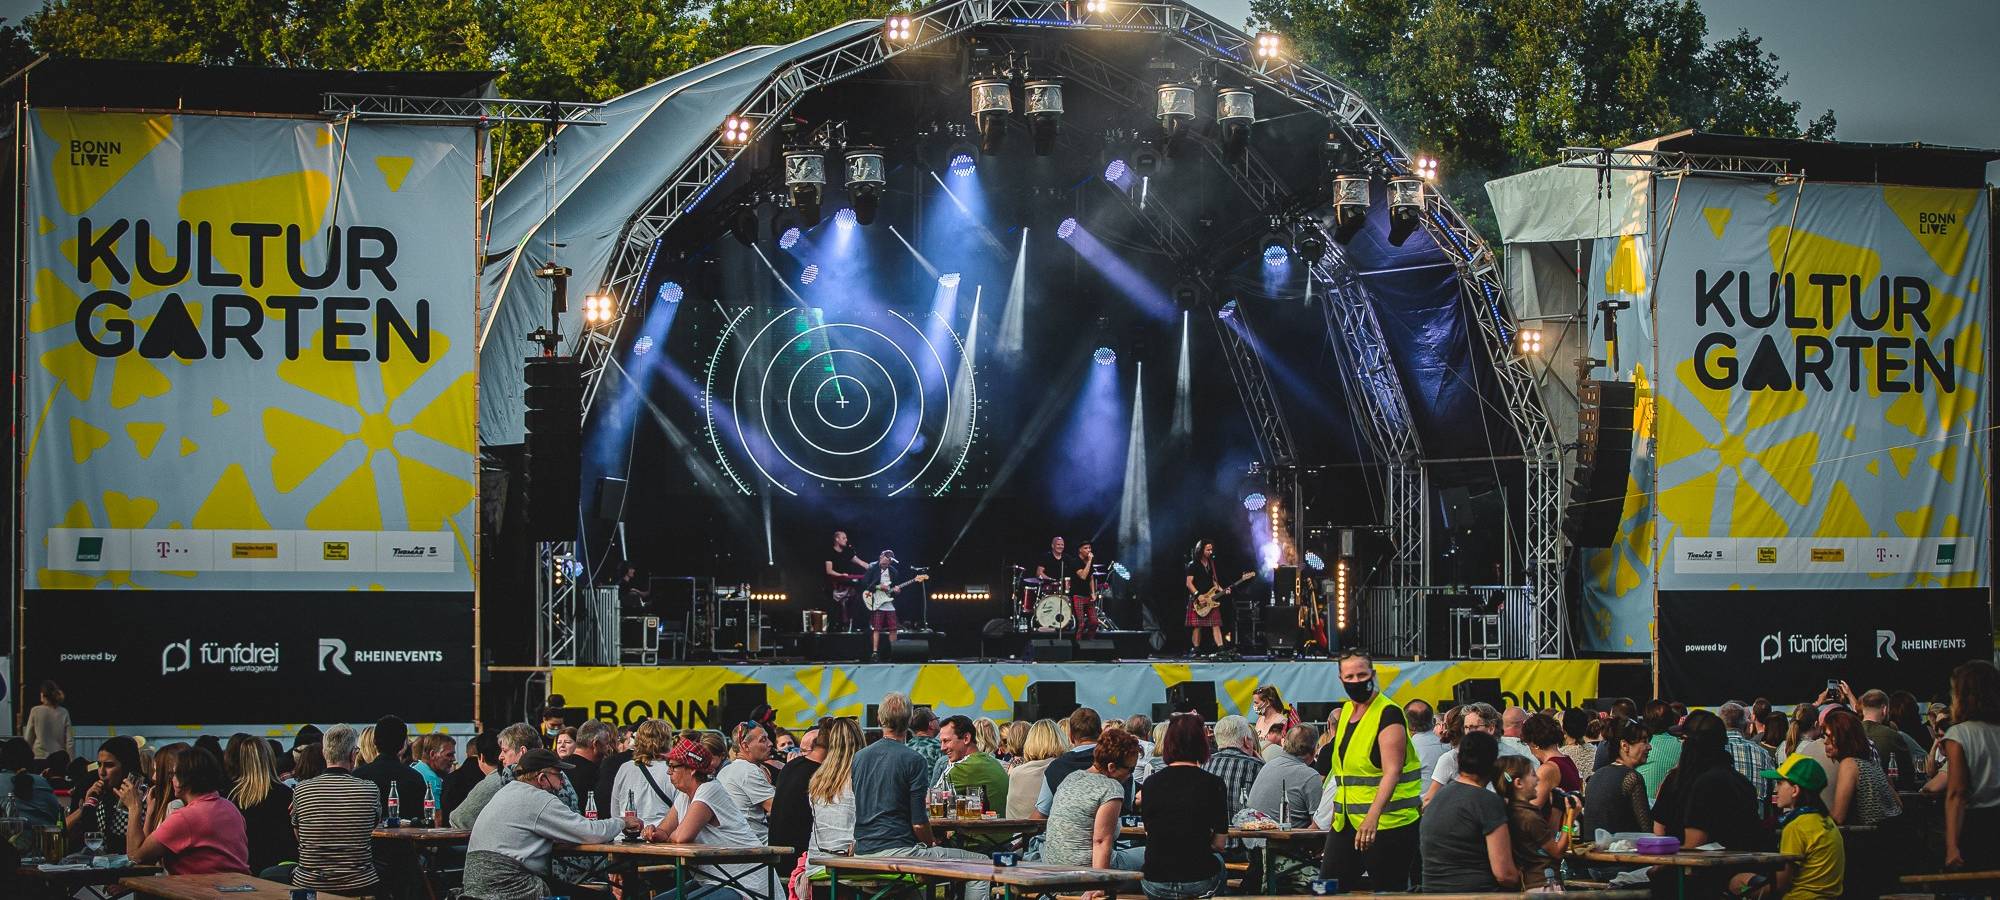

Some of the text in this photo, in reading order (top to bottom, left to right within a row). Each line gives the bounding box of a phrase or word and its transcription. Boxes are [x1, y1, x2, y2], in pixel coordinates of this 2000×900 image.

[71, 140, 122, 154] BONN
[71, 153, 109, 167] LIVE
[1919, 212, 1956, 224] BONN
[1919, 224, 1947, 235] LIVE
[77, 216, 398, 292] KULTUR
[1694, 268, 1931, 332] KULTUR
[75, 289, 431, 363] GARTEN
[1693, 331, 1955, 393] GARTEN
[1685, 643, 1728, 652] powered by
[1788, 633, 1848, 653] fünfdrei
[1901, 639, 1966, 650] RHEINEVENTS
[60, 652, 117, 662] powered by
[200, 642, 280, 664] fünfdrei
[354, 650, 443, 662] RHEINEVENTS
[230, 665, 278, 674] eventagentur
